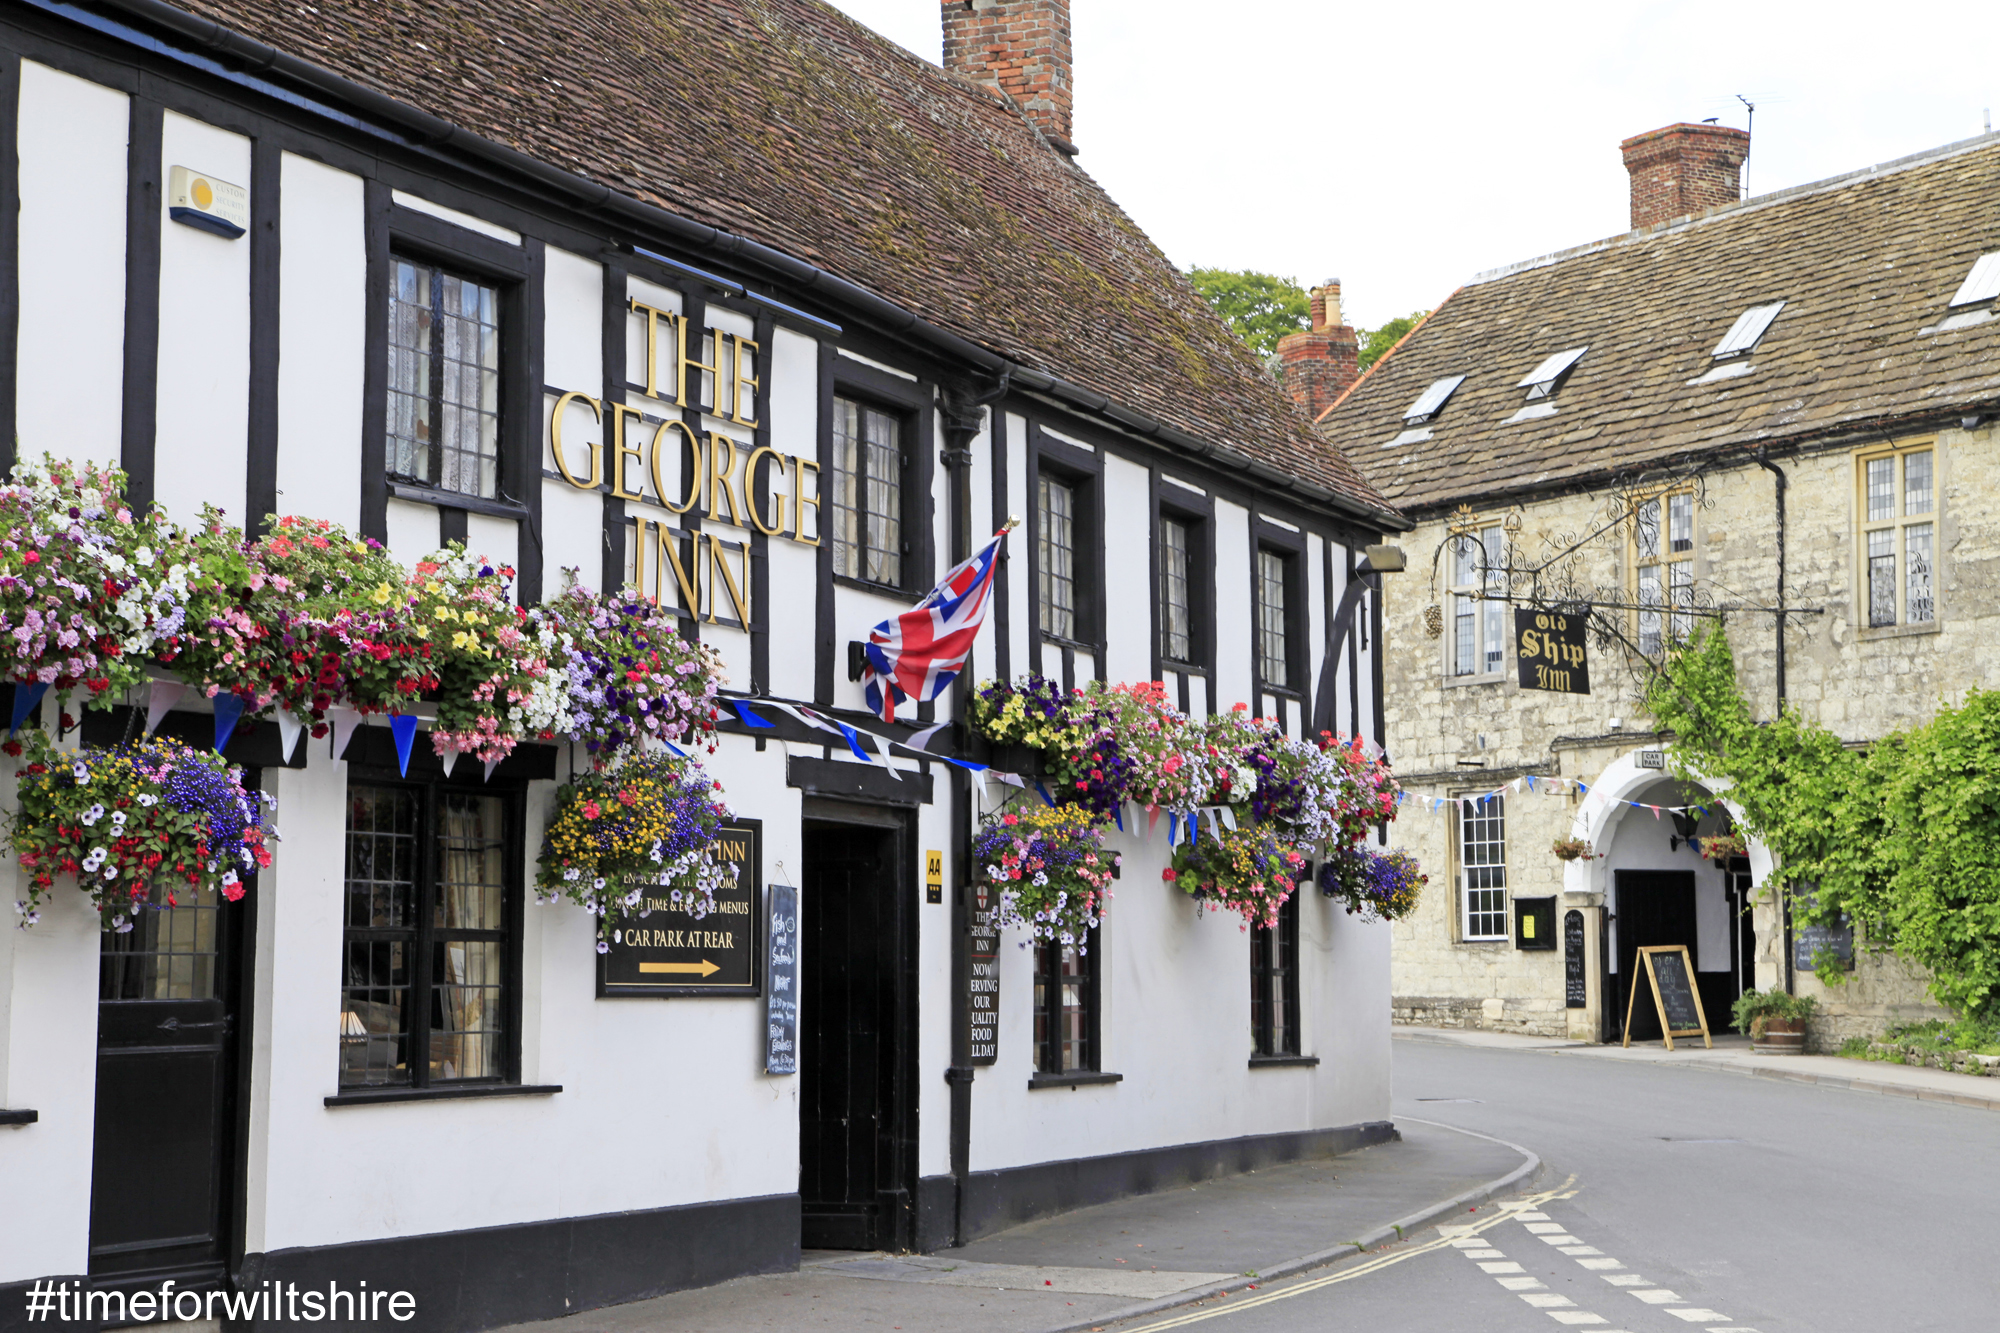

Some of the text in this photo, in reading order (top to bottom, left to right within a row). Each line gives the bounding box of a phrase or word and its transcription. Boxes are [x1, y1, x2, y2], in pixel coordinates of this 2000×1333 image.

[216, 183, 245, 199] CUSTOM
[216, 196, 244, 211] SECURITY
[216, 208, 245, 223] SERVICES
[630, 296, 759, 429] THE
[551, 391, 822, 547] GEORGE
[633, 515, 752, 634] INN
[1535, 613, 1567, 632] Old
[1520, 629, 1584, 669] Ship
[1535, 664, 1572, 692] Inn
[717, 839, 746, 862] INN
[928, 858, 941, 876] AA
[646, 897, 668, 911] TIME
[670, 899, 678, 912] &
[719, 901, 749, 915] MENUS
[625, 929, 735, 949] CAR PARK AT REAR
[976, 940, 989, 951] INN
[973, 963, 992, 976] NOW
[970, 979, 998, 992] ERVING
[974, 995, 990, 1009] OUR
[971, 1012, 998, 1025] UALITY
[971, 1028, 992, 1041] FOOD
[971, 1044, 996, 1057] LL DAY
